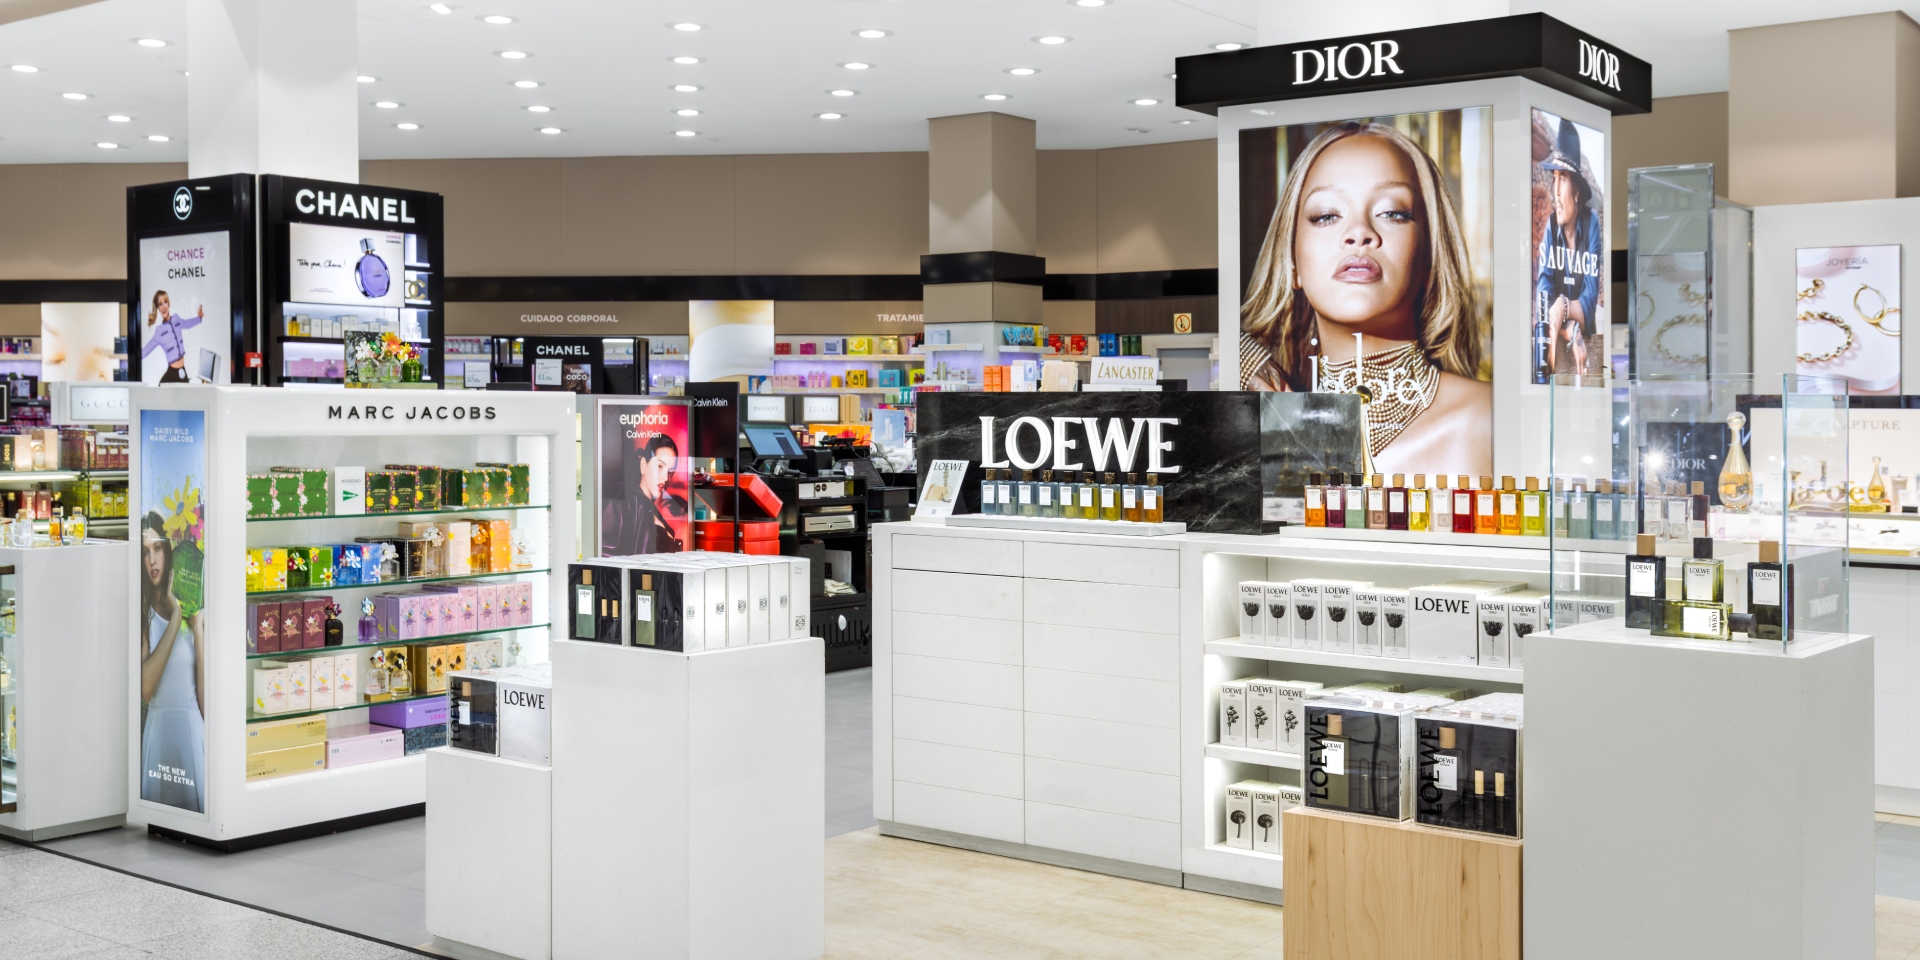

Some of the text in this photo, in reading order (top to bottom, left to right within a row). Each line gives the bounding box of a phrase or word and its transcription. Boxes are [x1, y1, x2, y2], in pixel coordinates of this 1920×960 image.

[1292, 39, 1404, 85] DIOR
[1579, 39, 1621, 91] DIOR
[295, 188, 416, 224] CHANEL
[167, 248, 205, 261] CHANCE
[1539, 242, 1598, 277] SAUVAGE
[167, 266, 206, 280] CHANEL
[520, 314, 619, 323] CUIDADO CORPORAL
[536, 345, 590, 356] CHANEL
[1097, 362, 1154, 380] LANCASTER
[712, 398, 728, 407] Klein
[328, 405, 497, 420] MARC JACOBS
[619, 411, 669, 429] euphoria
[154, 427, 189, 436] DAISY WILD
[626, 430, 662, 439] Calvin Klein
[150, 434, 194, 444] MARC JACOBS
[978, 415, 1182, 474] LOEWE
[933, 462, 965, 472] LOEWE
[1672, 458, 1706, 470] DIOR
[1632, 563, 1653, 571] LOEWE
[1689, 567, 1711, 575] LOEWE
[1755, 571, 1777, 579] LOEWE
[1241, 586, 1262, 594] LOEWE
[1293, 585, 1319, 594] LOEWE
[1325, 586, 1350, 595] LOEWE
[1356, 594, 1378, 602] LOEWE
[1414, 597, 1470, 614] LOEWE
[1480, 603, 1505, 612] LOEWE
[1511, 605, 1537, 614] LOEWE
[1581, 604, 1612, 614] LOEWE
[1222, 687, 1243, 695] LOEWE
[1249, 684, 1274, 694] LOEWE
[1279, 688, 1303, 698] LOEWE
[504, 689, 545, 710] LOEWE
[450, 681, 463, 743] LOEWE
[1310, 713, 1329, 800] LOEWE
[157, 764, 186, 777] THE NEW
[1420, 726, 1442, 815] LOEWE
[149, 770, 195, 787] EAU SO EXTRA
[1228, 789, 1249, 798] LOEWE
[1255, 793, 1276, 802] LOEWE
